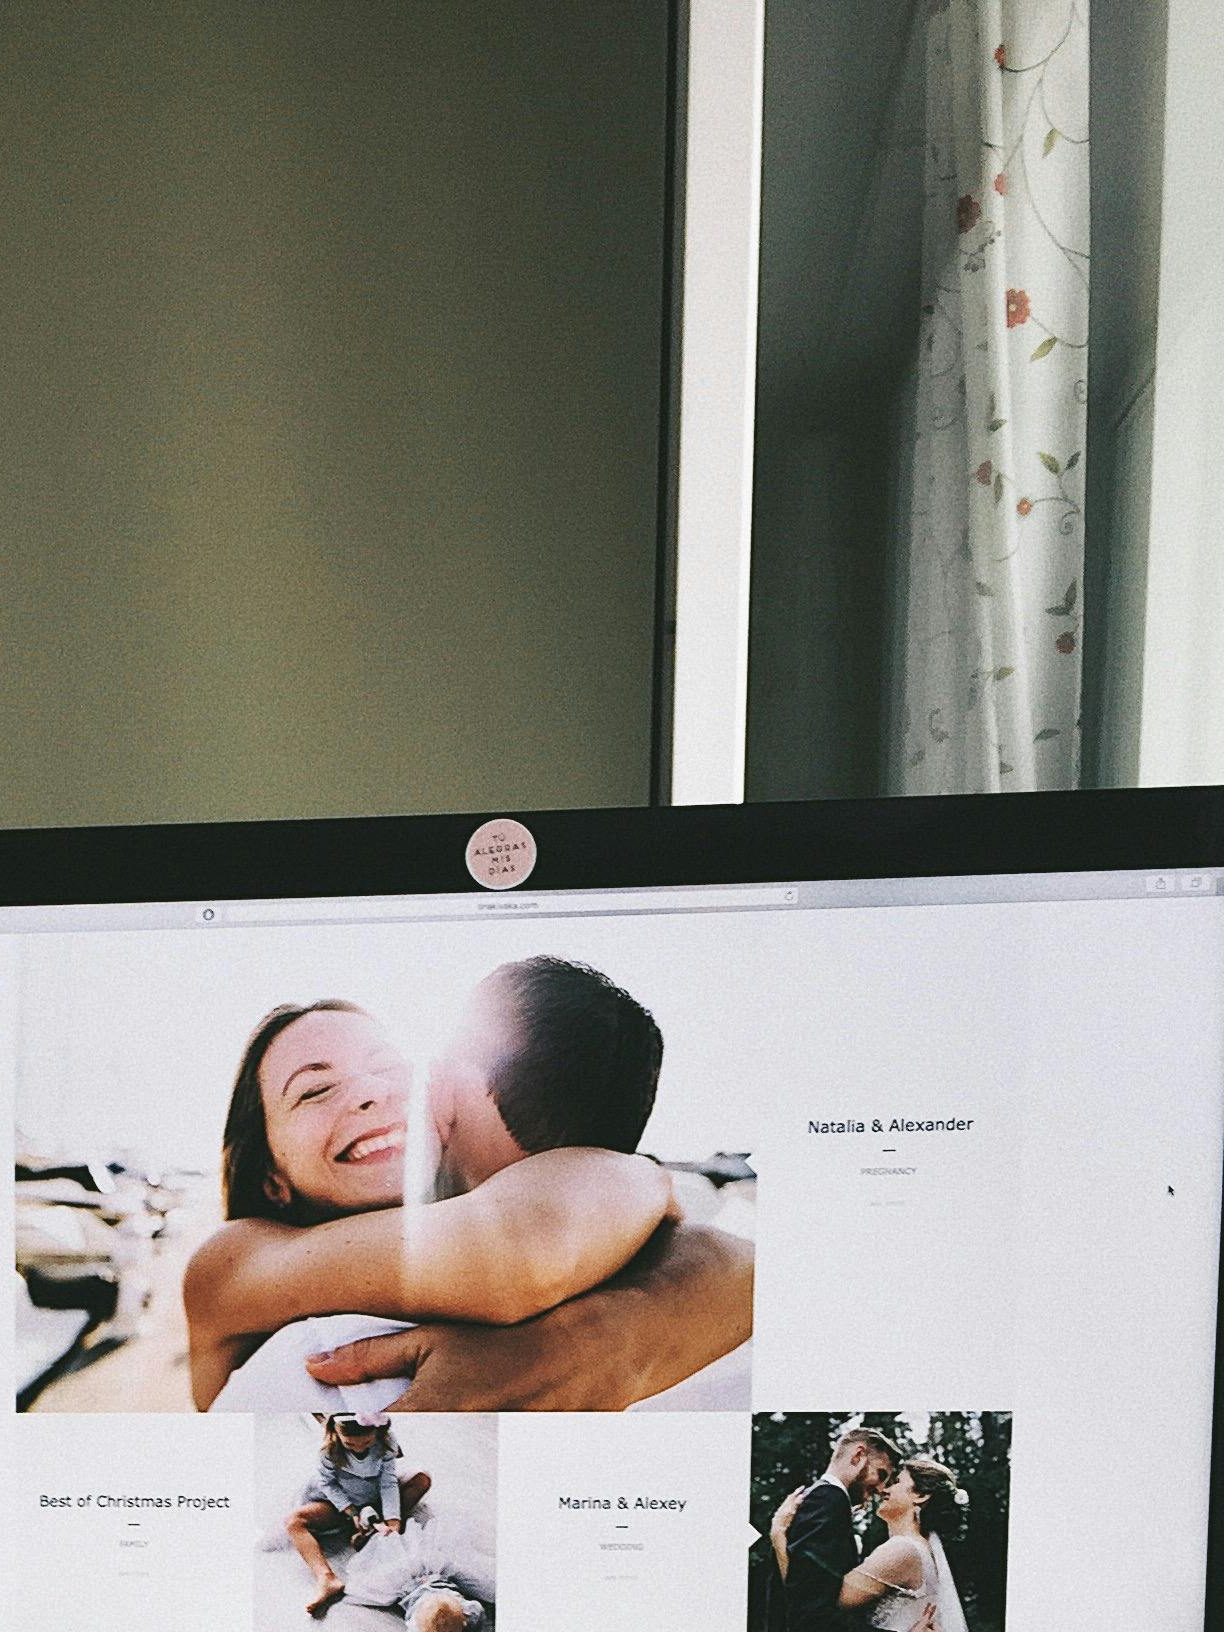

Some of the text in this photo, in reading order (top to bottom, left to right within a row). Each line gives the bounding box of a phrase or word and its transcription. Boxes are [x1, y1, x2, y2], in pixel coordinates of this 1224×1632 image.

[807, 1117, 975, 1134] Natalia & Alexander
[860, 1167, 917, 1176] PREGNANCY
[39, 1494, 231, 1512] Best of Christmas Project
[558, 1496, 687, 1513] Marina & Alexey
